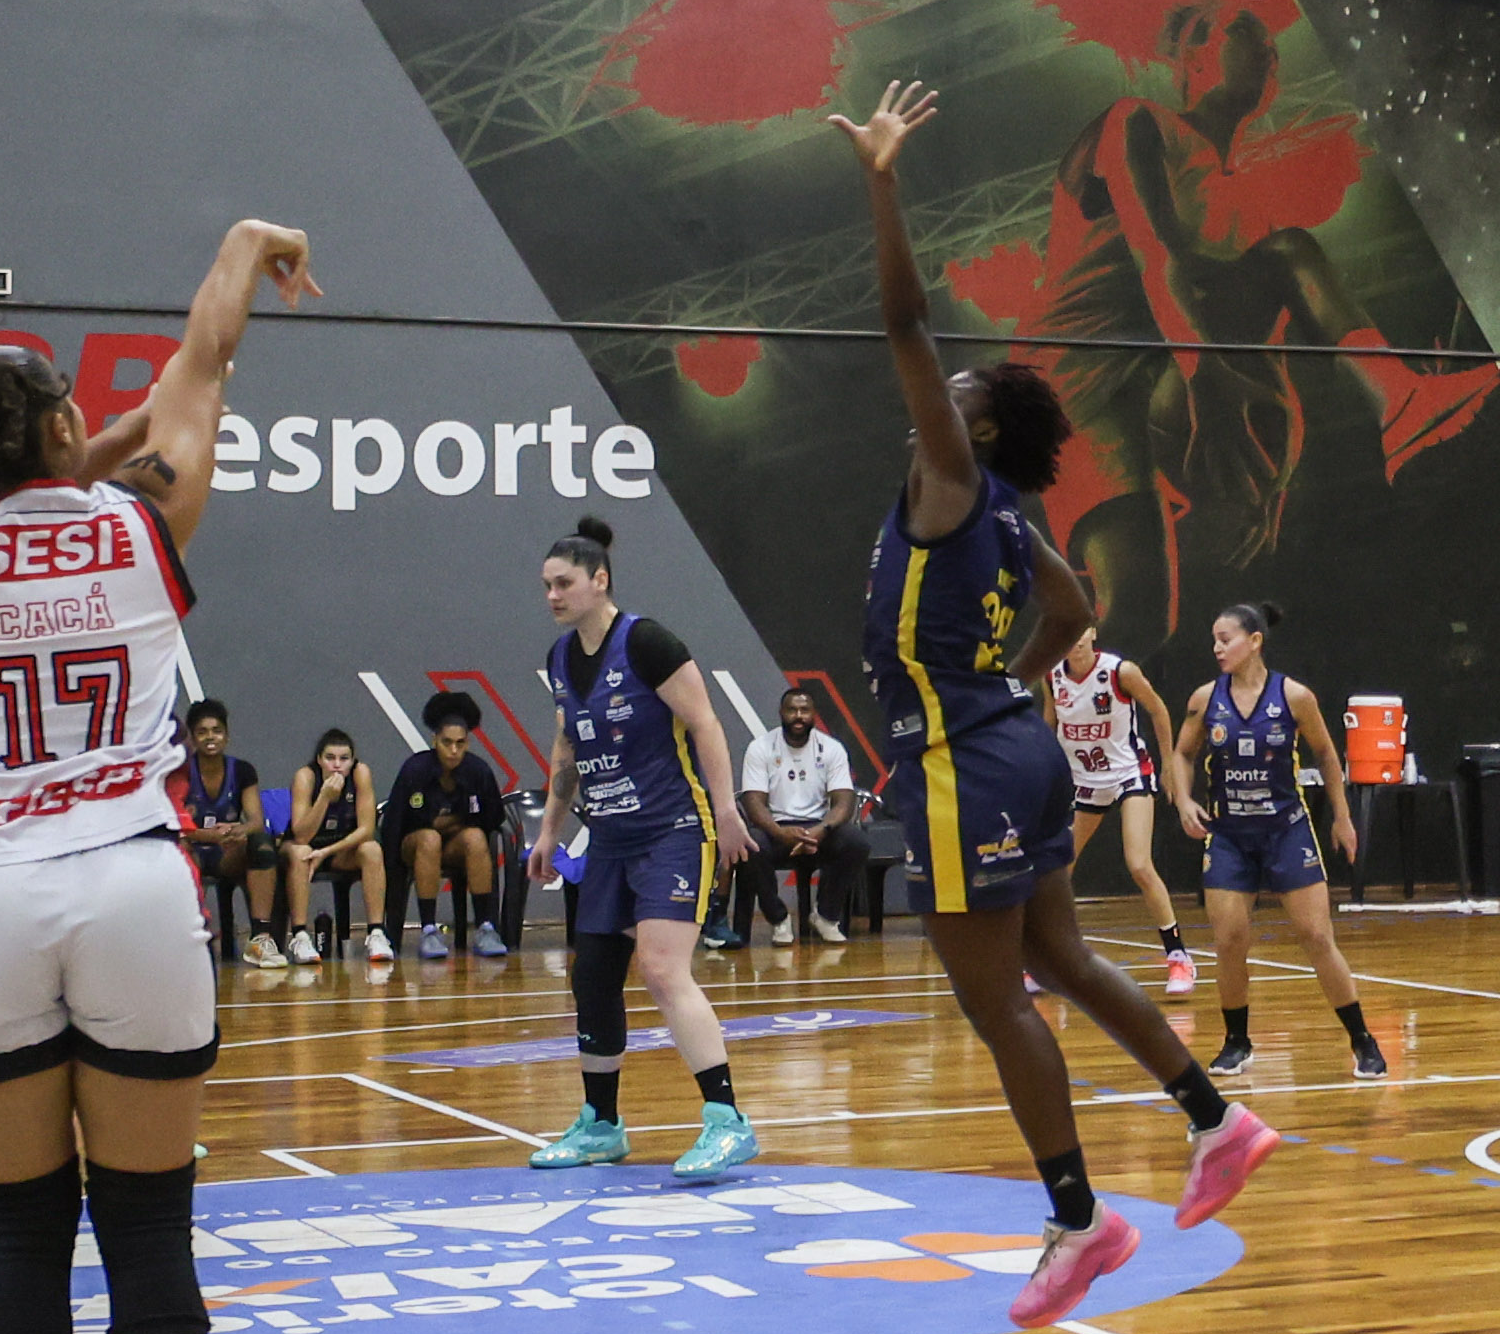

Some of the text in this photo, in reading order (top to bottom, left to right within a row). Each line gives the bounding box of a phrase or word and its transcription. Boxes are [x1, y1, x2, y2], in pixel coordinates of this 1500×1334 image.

[210, 404, 657, 511] esporte
[1065, 722, 1107, 740] SESI
[1225, 769, 1269, 783] pontz
[306, 1198, 447, 1213] POVO
[223, 1225, 756, 1269] GOVERNO DO
[68, 1254, 676, 1320] CAIX
